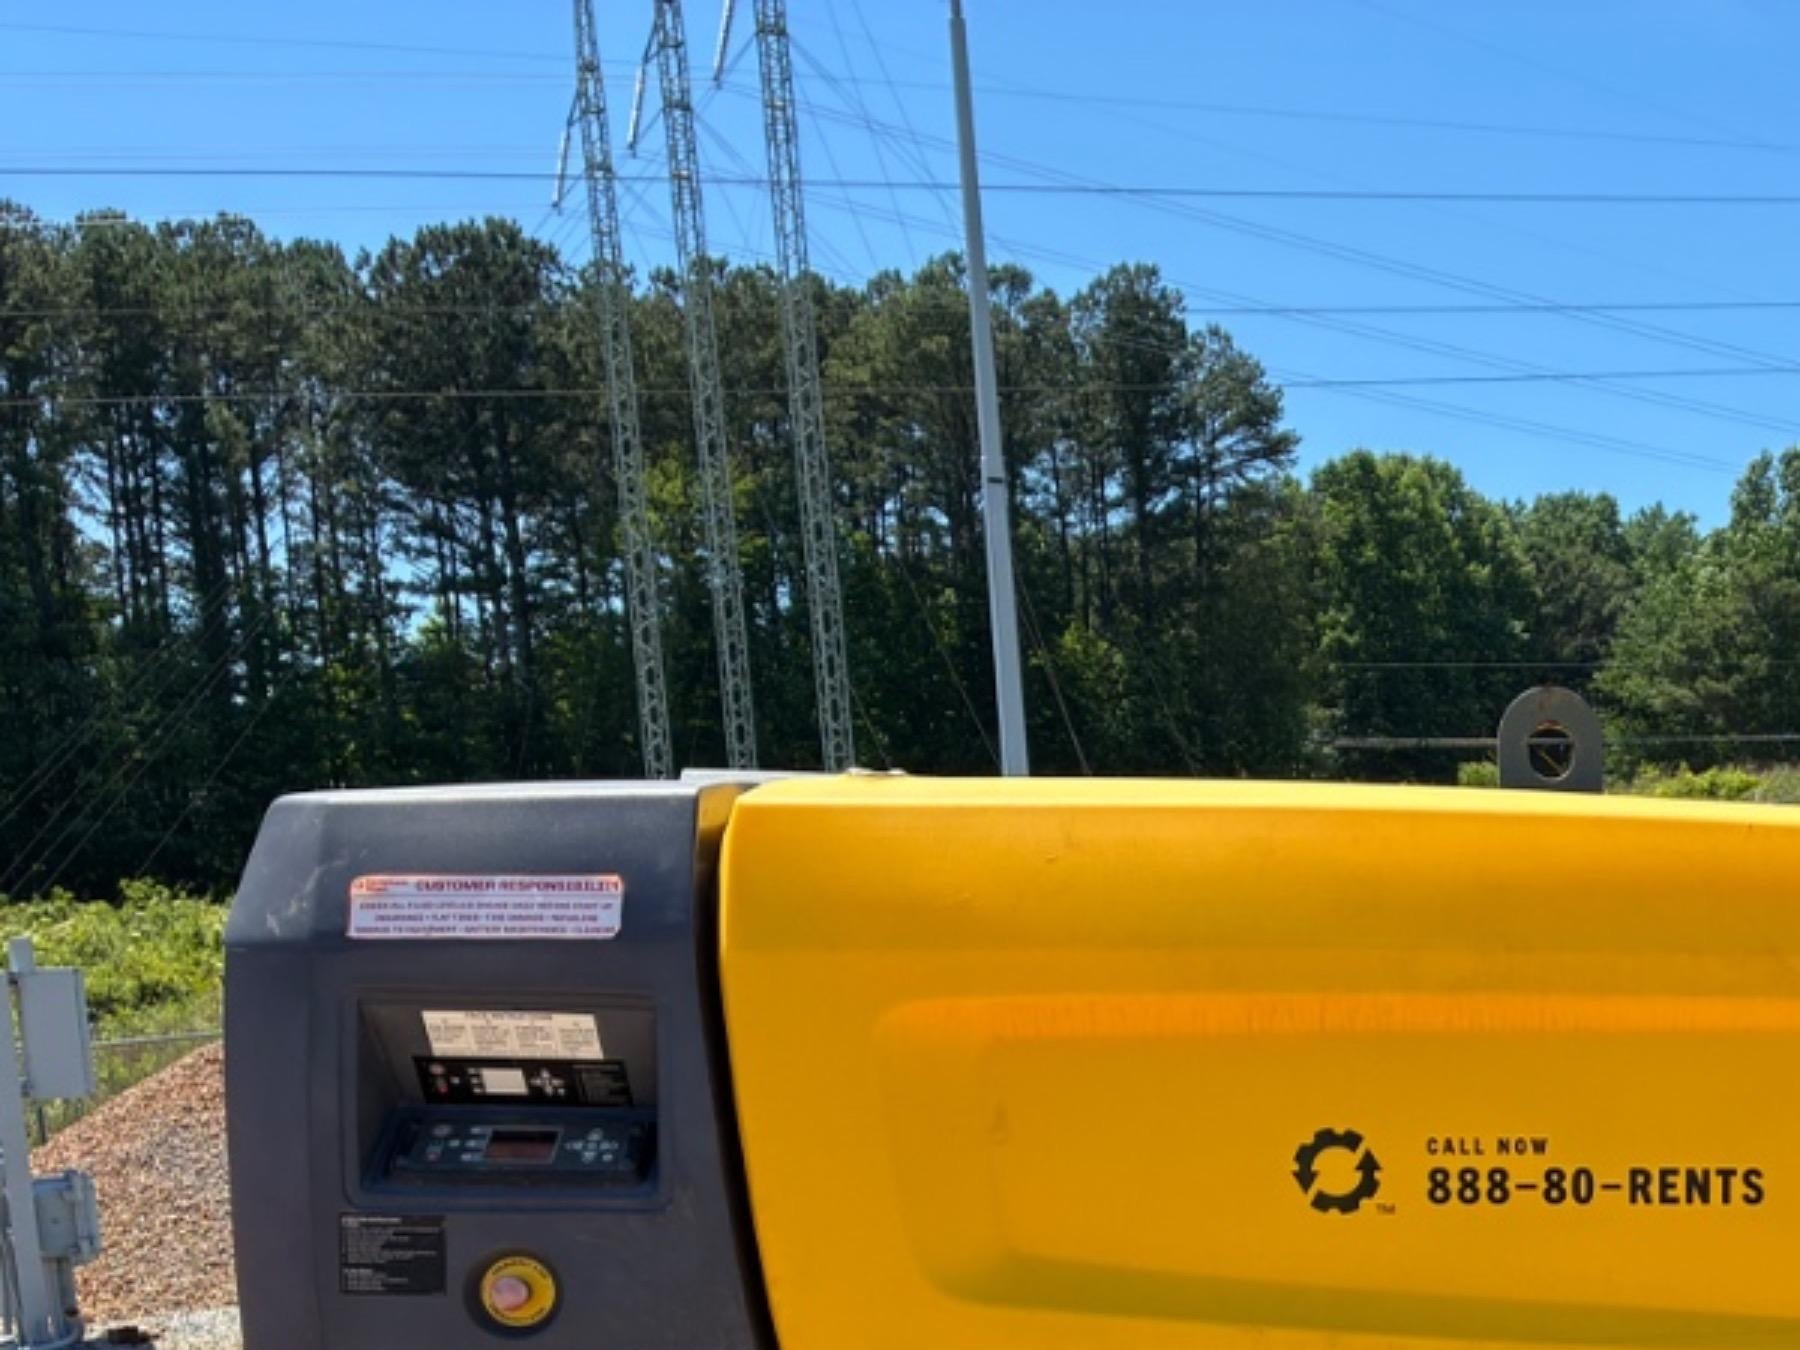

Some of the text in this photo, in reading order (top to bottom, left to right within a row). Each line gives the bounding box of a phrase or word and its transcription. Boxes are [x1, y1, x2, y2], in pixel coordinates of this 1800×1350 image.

[416, 879, 496, 892] CUSTOMER
[498, 880, 619, 893] RESPONSIBILITY
[1426, 1137, 1549, 1155] CALL NOW
[1427, 1167, 1765, 1205] 888-80-RENTS
